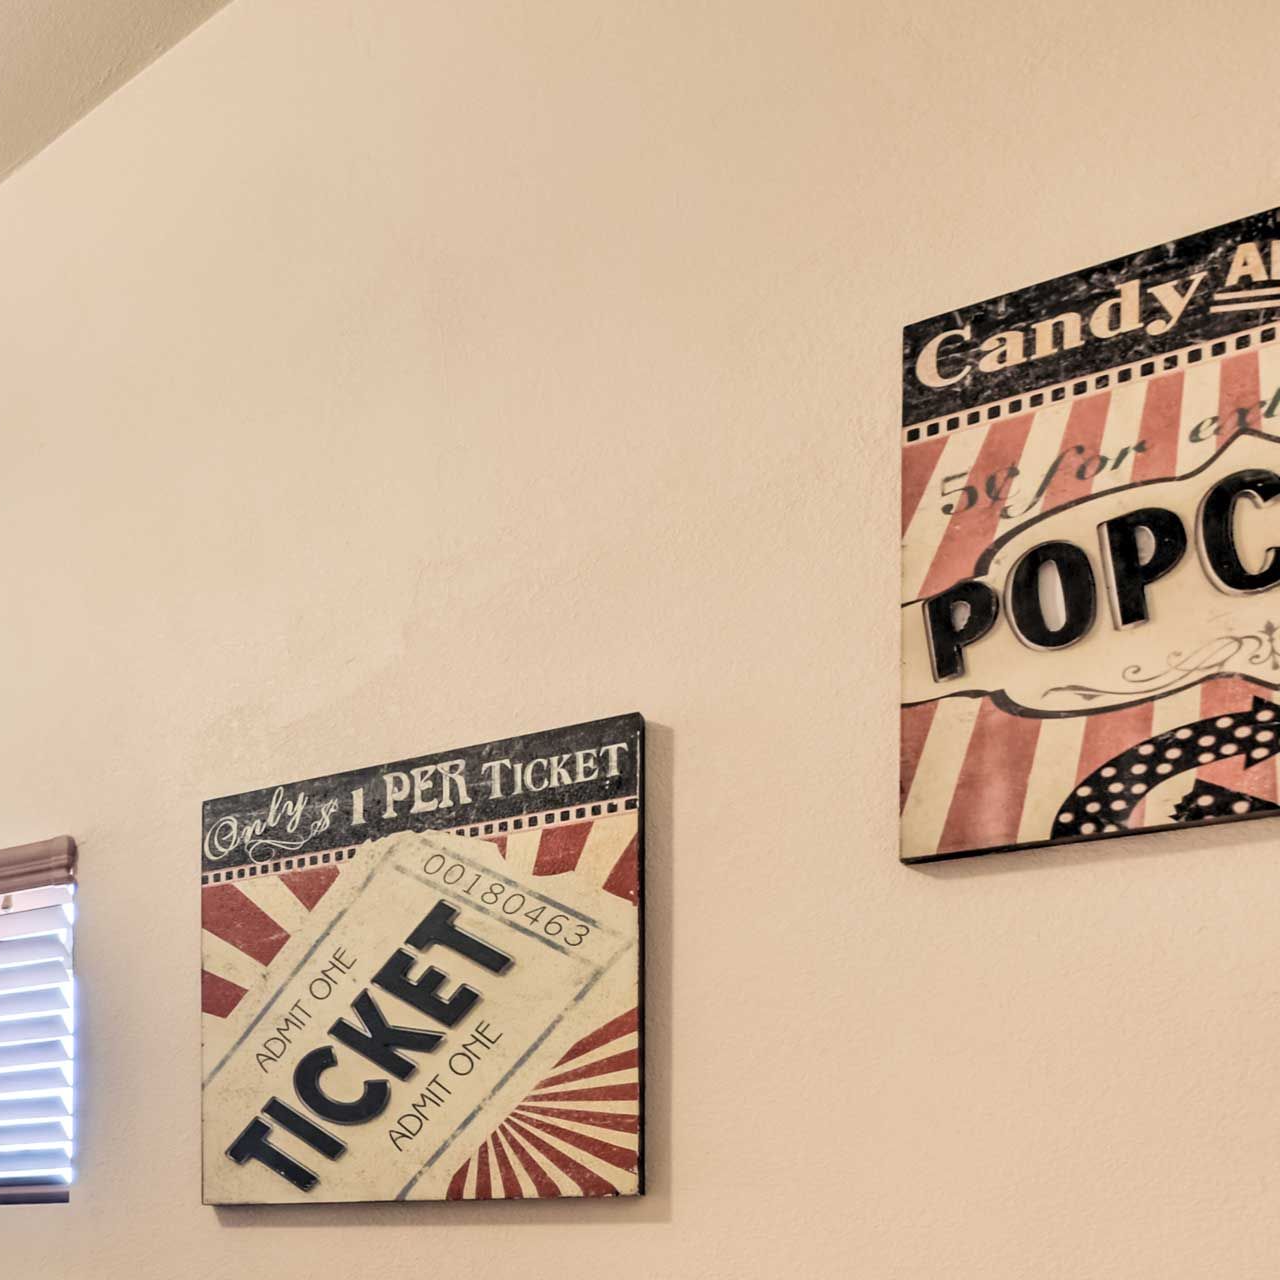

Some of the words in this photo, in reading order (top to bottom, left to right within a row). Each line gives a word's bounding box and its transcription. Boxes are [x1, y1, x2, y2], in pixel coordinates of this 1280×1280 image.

[914, 271, 1208, 389] Candy
[1225, 239, 1280, 288] A
[999, 444, 1147, 520] for
[922, 467, 1280, 684] POPC
[203, 786, 309, 861] Only
[382, 758, 473, 819] PER
[480, 741, 630, 800] TICKET
[422, 853, 591, 948] 00180463
[223, 898, 518, 1194] TICKET
[254, 998, 313, 1074] ADMIT
[308, 945, 359, 1001] ONE
[388, 1072, 453, 1153] ADMIT
[448, 1019, 504, 1077] ONE
